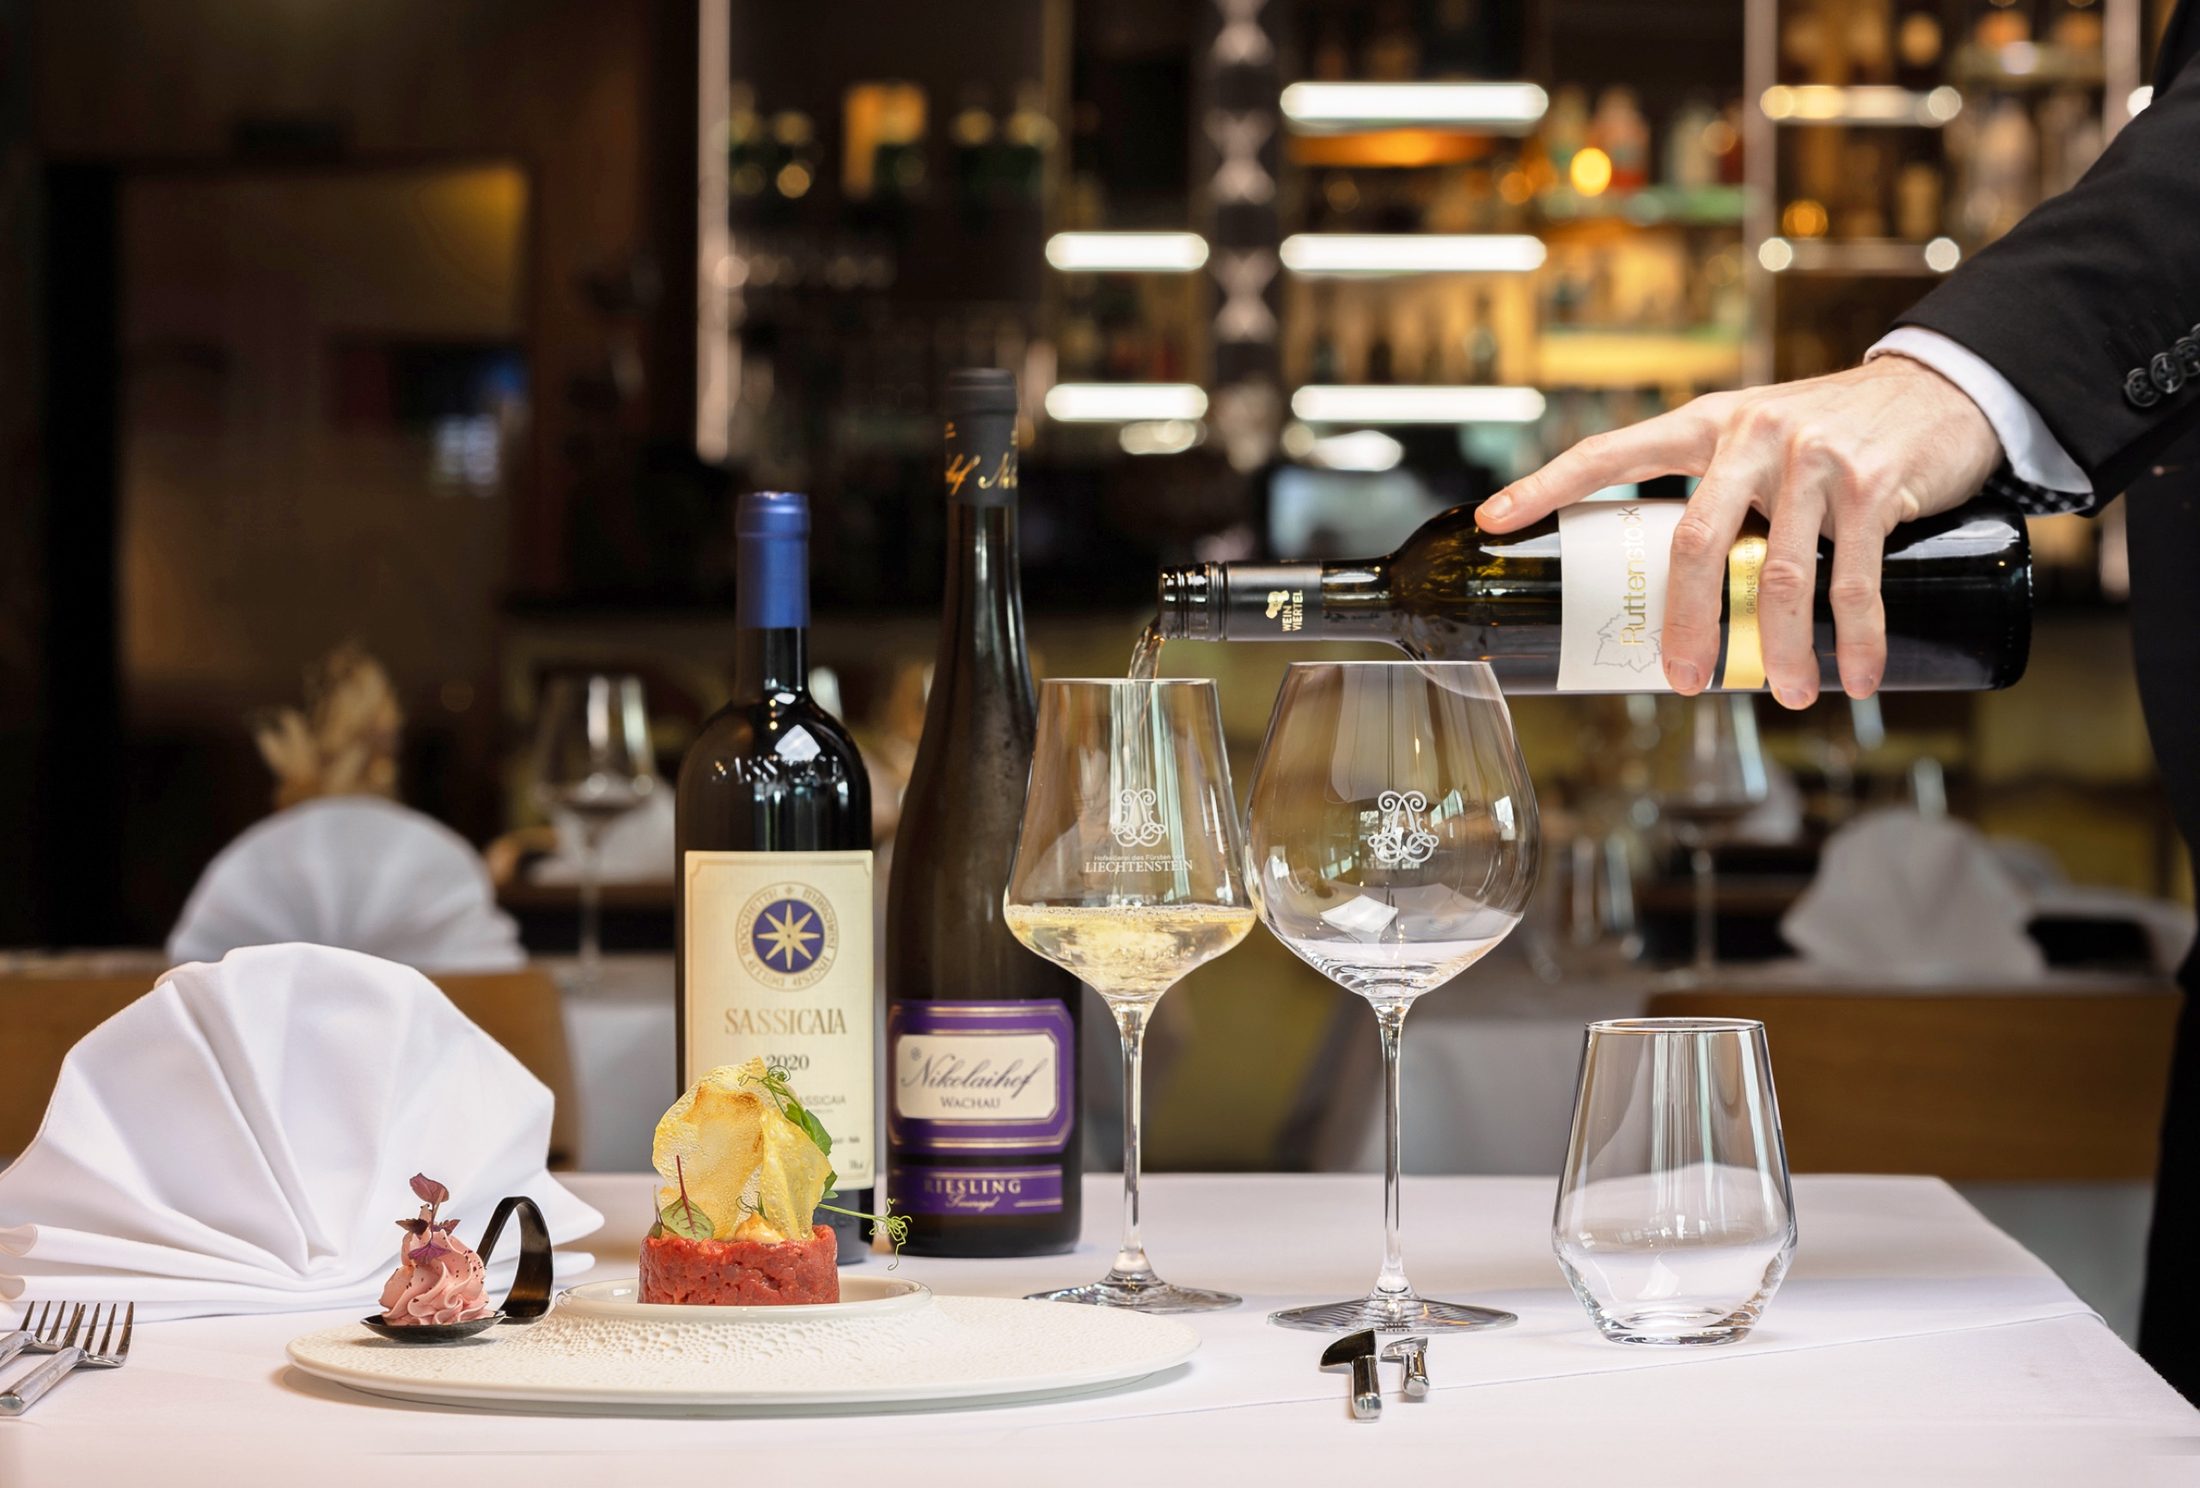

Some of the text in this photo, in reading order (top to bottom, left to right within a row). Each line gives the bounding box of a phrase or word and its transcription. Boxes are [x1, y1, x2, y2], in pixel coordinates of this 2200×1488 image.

[1618, 507, 1647, 645] Ruttenstock
[1282, 605, 1293, 632] WEIN
[1292, 590, 1304, 632] VIERTEL
[1085, 860, 1193, 873] LIECHTENSTEIN
[724, 1008, 847, 1035] SASSICAIA
[766, 1054, 810, 1071] 2020
[901, 1053, 1049, 1099] Nikolaihof
[940, 1097, 1001, 1109] WACHAU
[925, 1179, 1022, 1194] RIESLING
